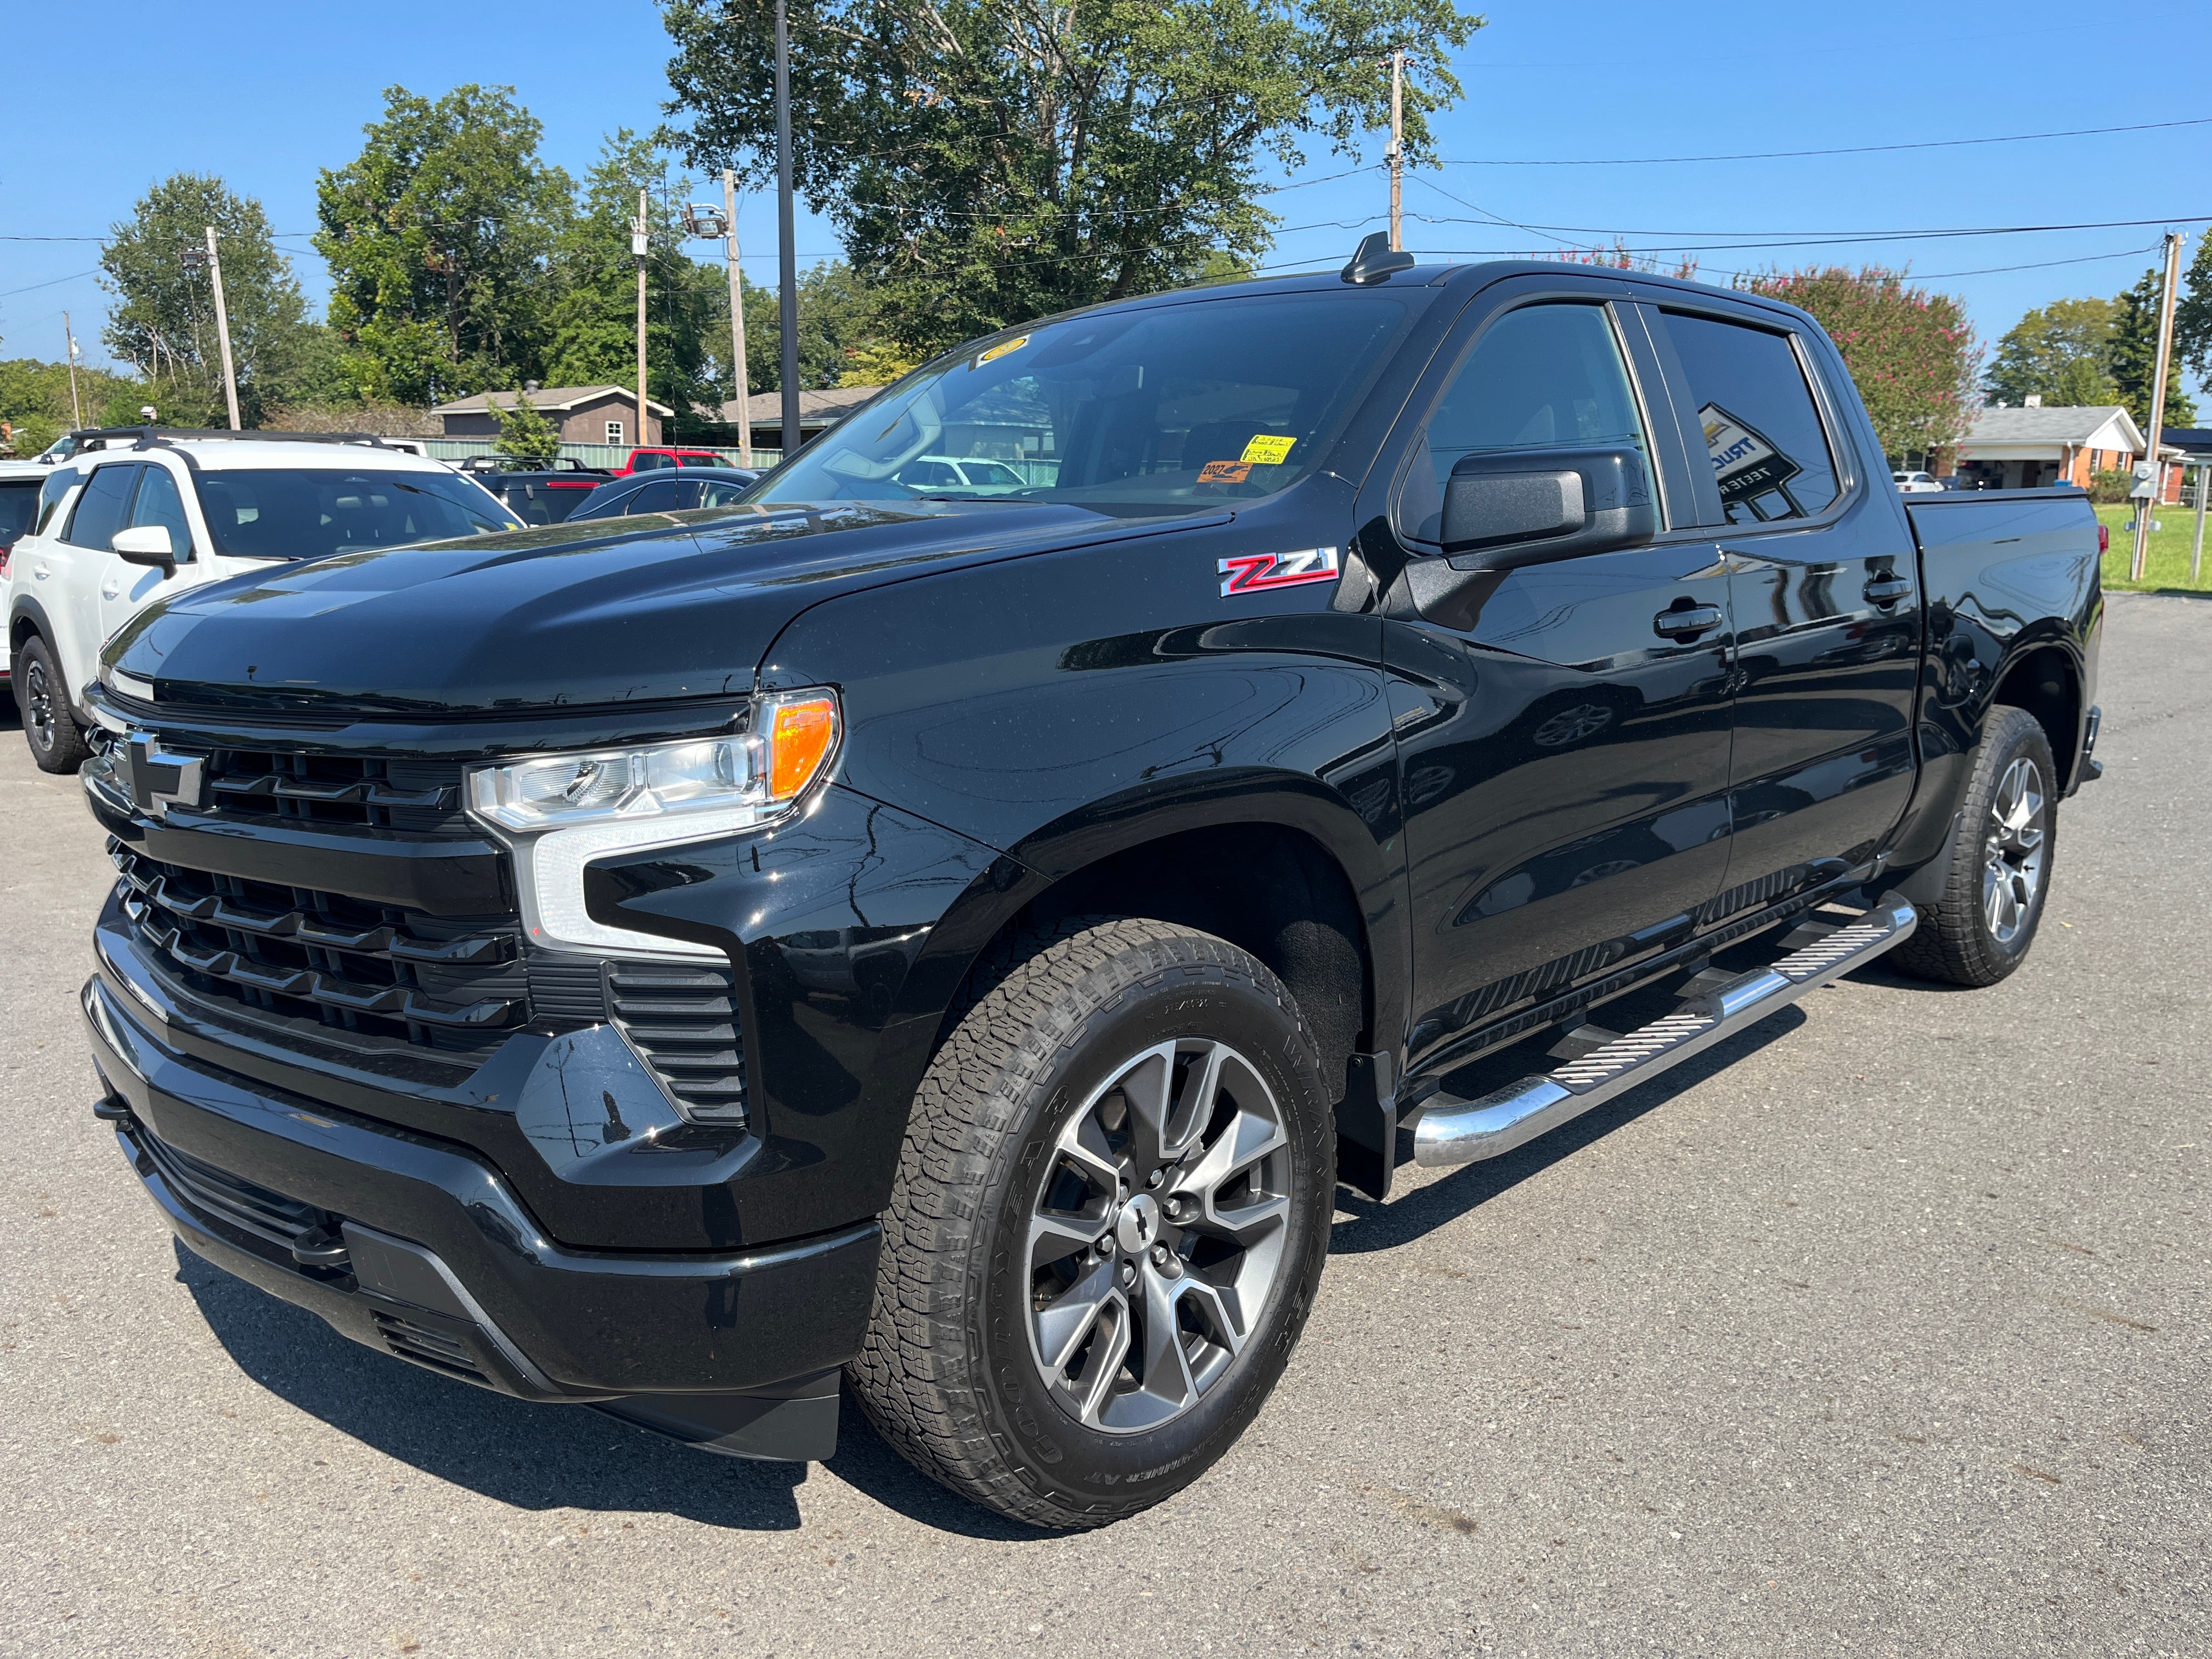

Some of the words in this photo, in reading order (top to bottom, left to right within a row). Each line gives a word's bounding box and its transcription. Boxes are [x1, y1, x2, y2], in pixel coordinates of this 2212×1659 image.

[1203, 465, 1225, 475] 2027
[1216, 546, 1340, 597] Z71
[991, 1085, 1069, 1464] GOODYEAR
[1274, 1035, 1327, 1356] WRANGLER
